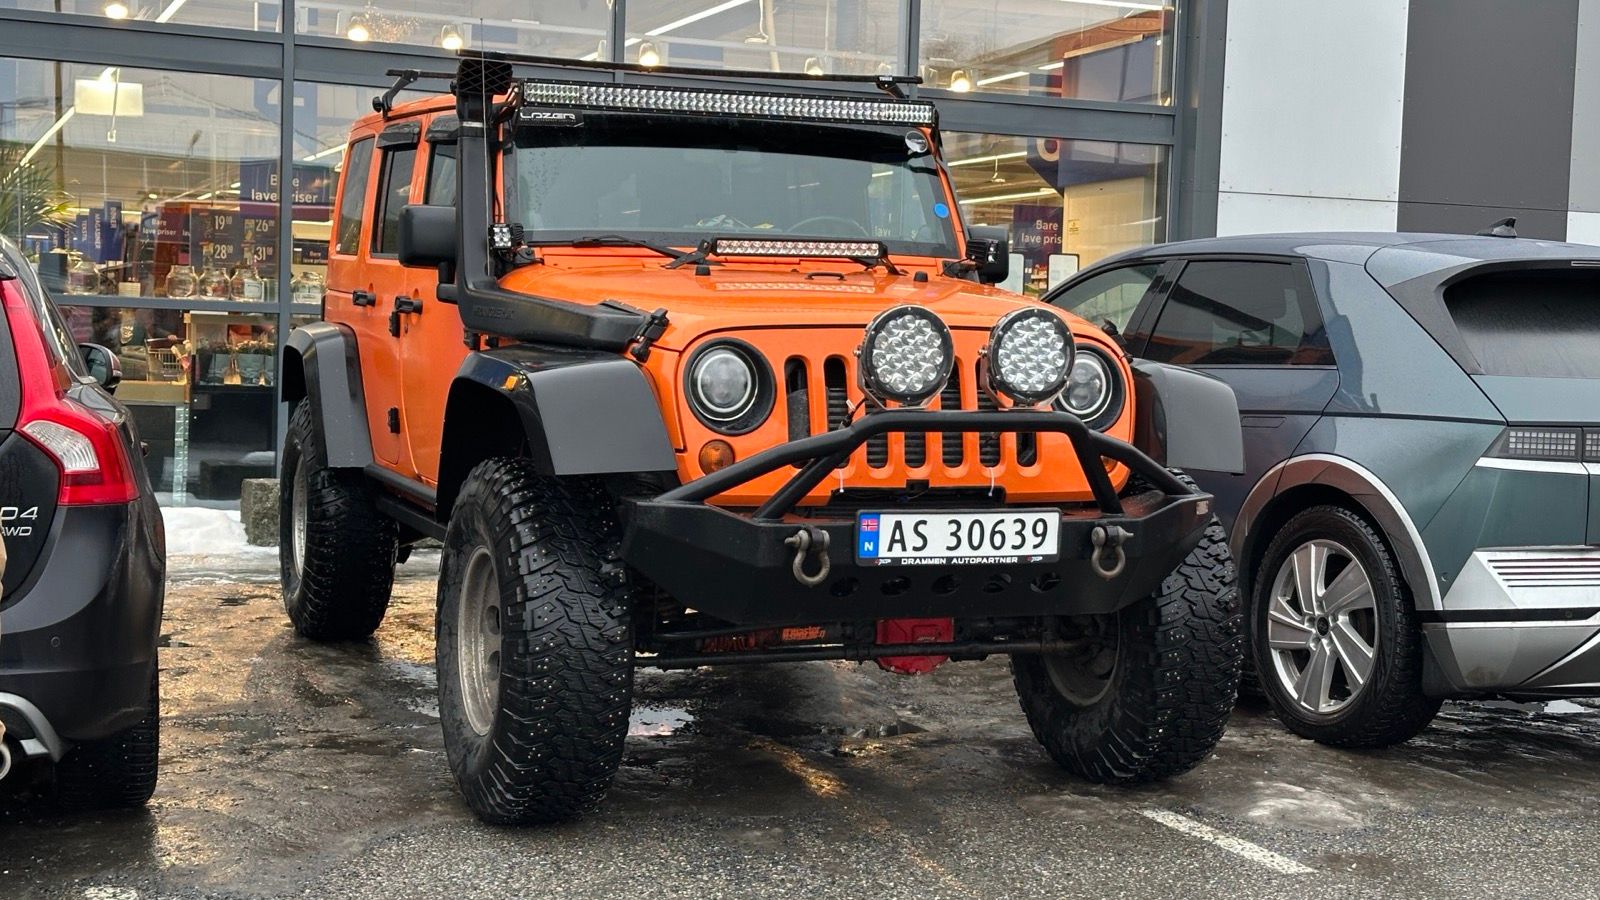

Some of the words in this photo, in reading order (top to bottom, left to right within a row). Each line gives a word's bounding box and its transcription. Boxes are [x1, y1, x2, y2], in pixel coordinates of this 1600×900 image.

[270, 174, 300, 187] Be
[251, 188, 278, 201] lave
[1035, 219, 1059, 231] Bare
[1021, 232, 1041, 244] lave
[887, 519, 928, 552] AS
[946, 517, 1048, 551] 30639
[864, 542, 874, 551] N
[901, 557, 947, 565] DRAMMEN
[951, 556, 1018, 565] AUTOPARTNER
